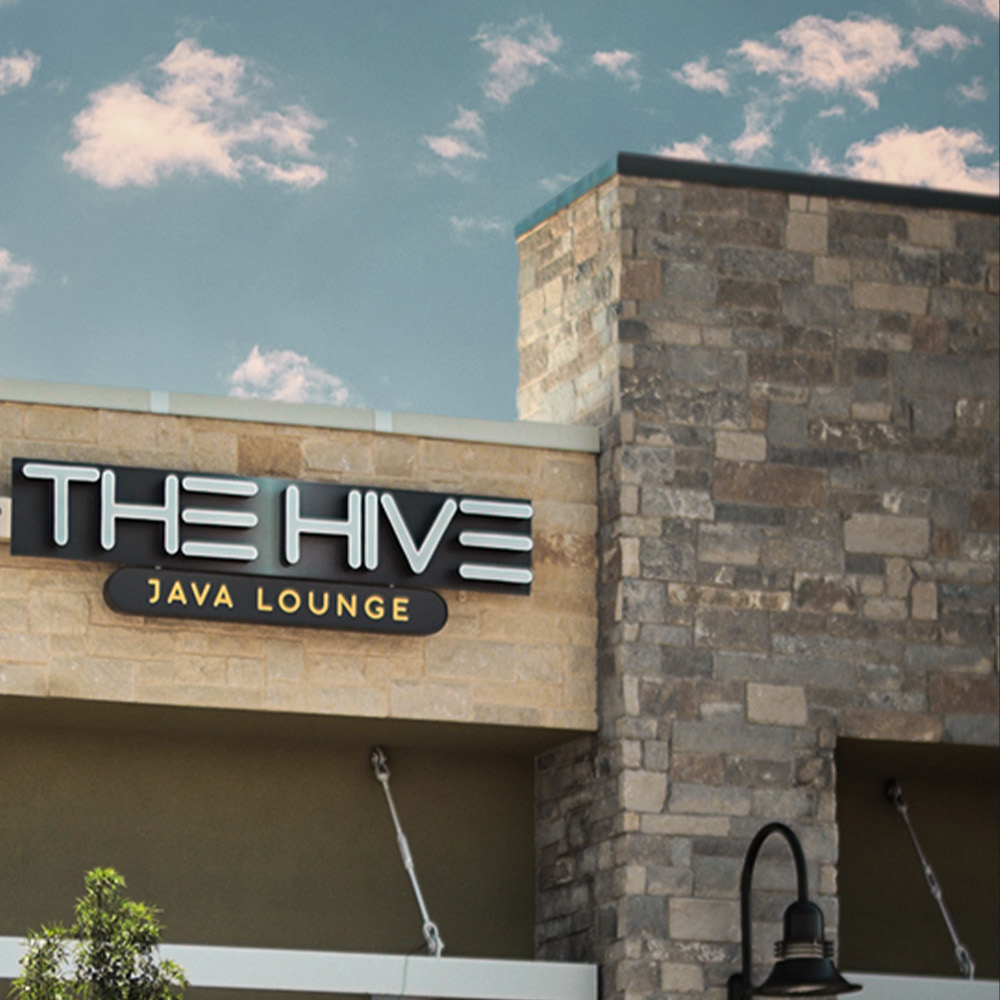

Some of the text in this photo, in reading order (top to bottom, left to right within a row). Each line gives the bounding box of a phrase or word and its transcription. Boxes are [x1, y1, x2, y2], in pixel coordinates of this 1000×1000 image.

[22, 463, 534, 584] THE HIVE
[148, 578, 410, 622] JAVA LOUNGE
